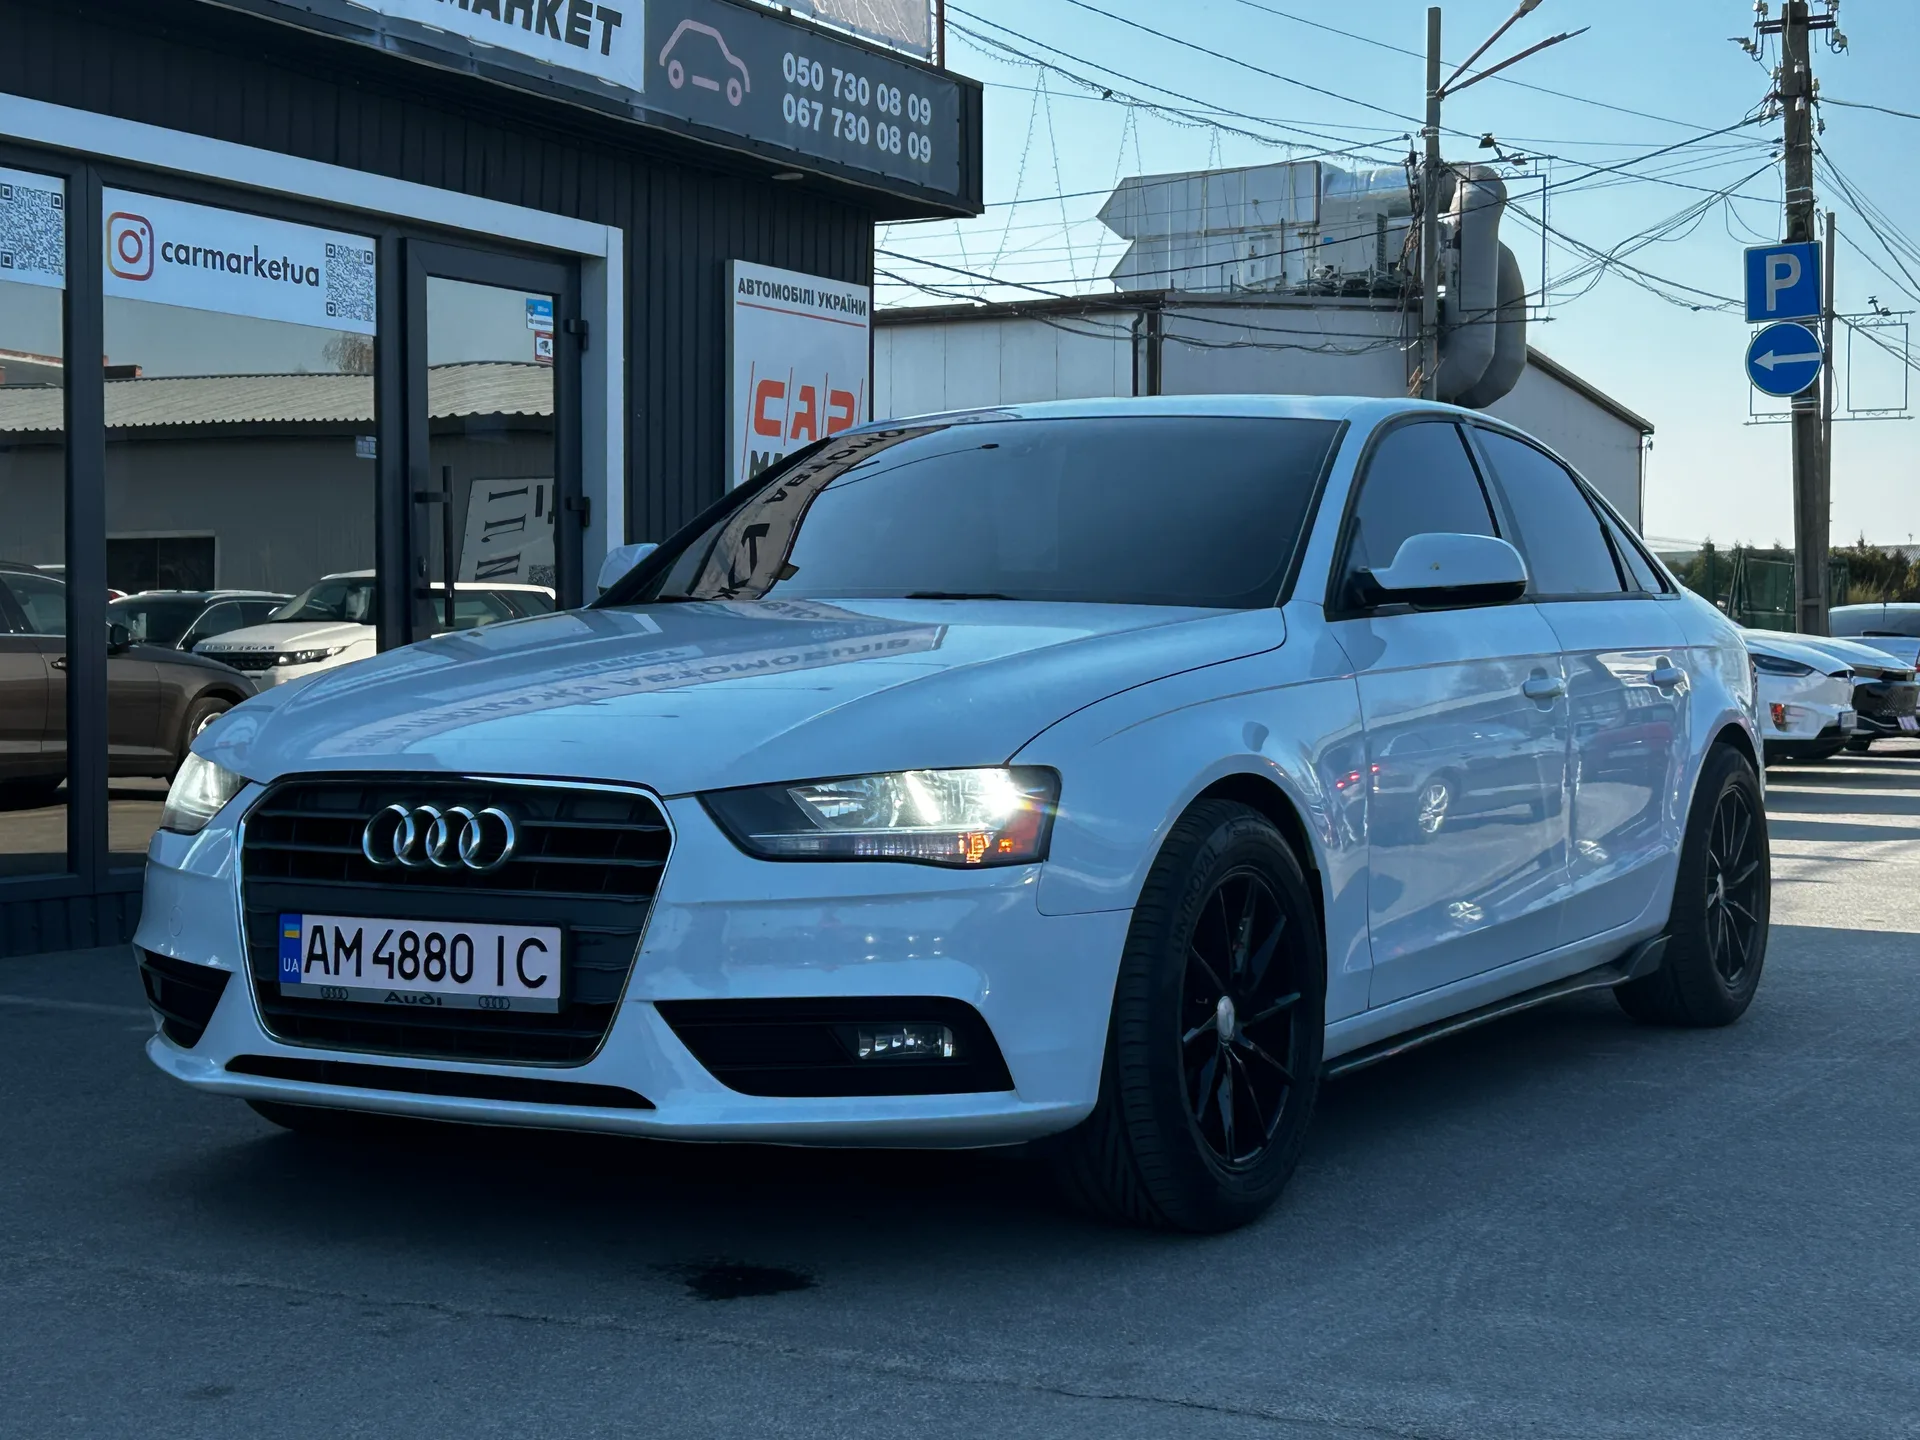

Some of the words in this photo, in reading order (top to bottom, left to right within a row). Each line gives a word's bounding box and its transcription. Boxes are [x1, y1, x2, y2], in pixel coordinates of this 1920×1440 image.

[783, 52, 823, 91] 050
[831, 67, 870, 106] 730
[876, 83, 901, 116] 08
[907, 93, 931, 126] 09
[783, 93, 823, 131] 067
[831, 108, 870, 145] 730
[876, 122, 901, 154] 08
[907, 132, 931, 163] 09
[161, 242, 319, 286] carmarketua
[1765, 254, 1801, 311] P
[738, 277, 814, 306] АВТОМОБІЛІ
[818, 291, 867, 316] УКРАЇНИ
[283, 958, 299, 973] UA
[372, 929, 474, 983] 4880
[497, 935, 548, 988] IC
[384, 991, 442, 1006] Audi
